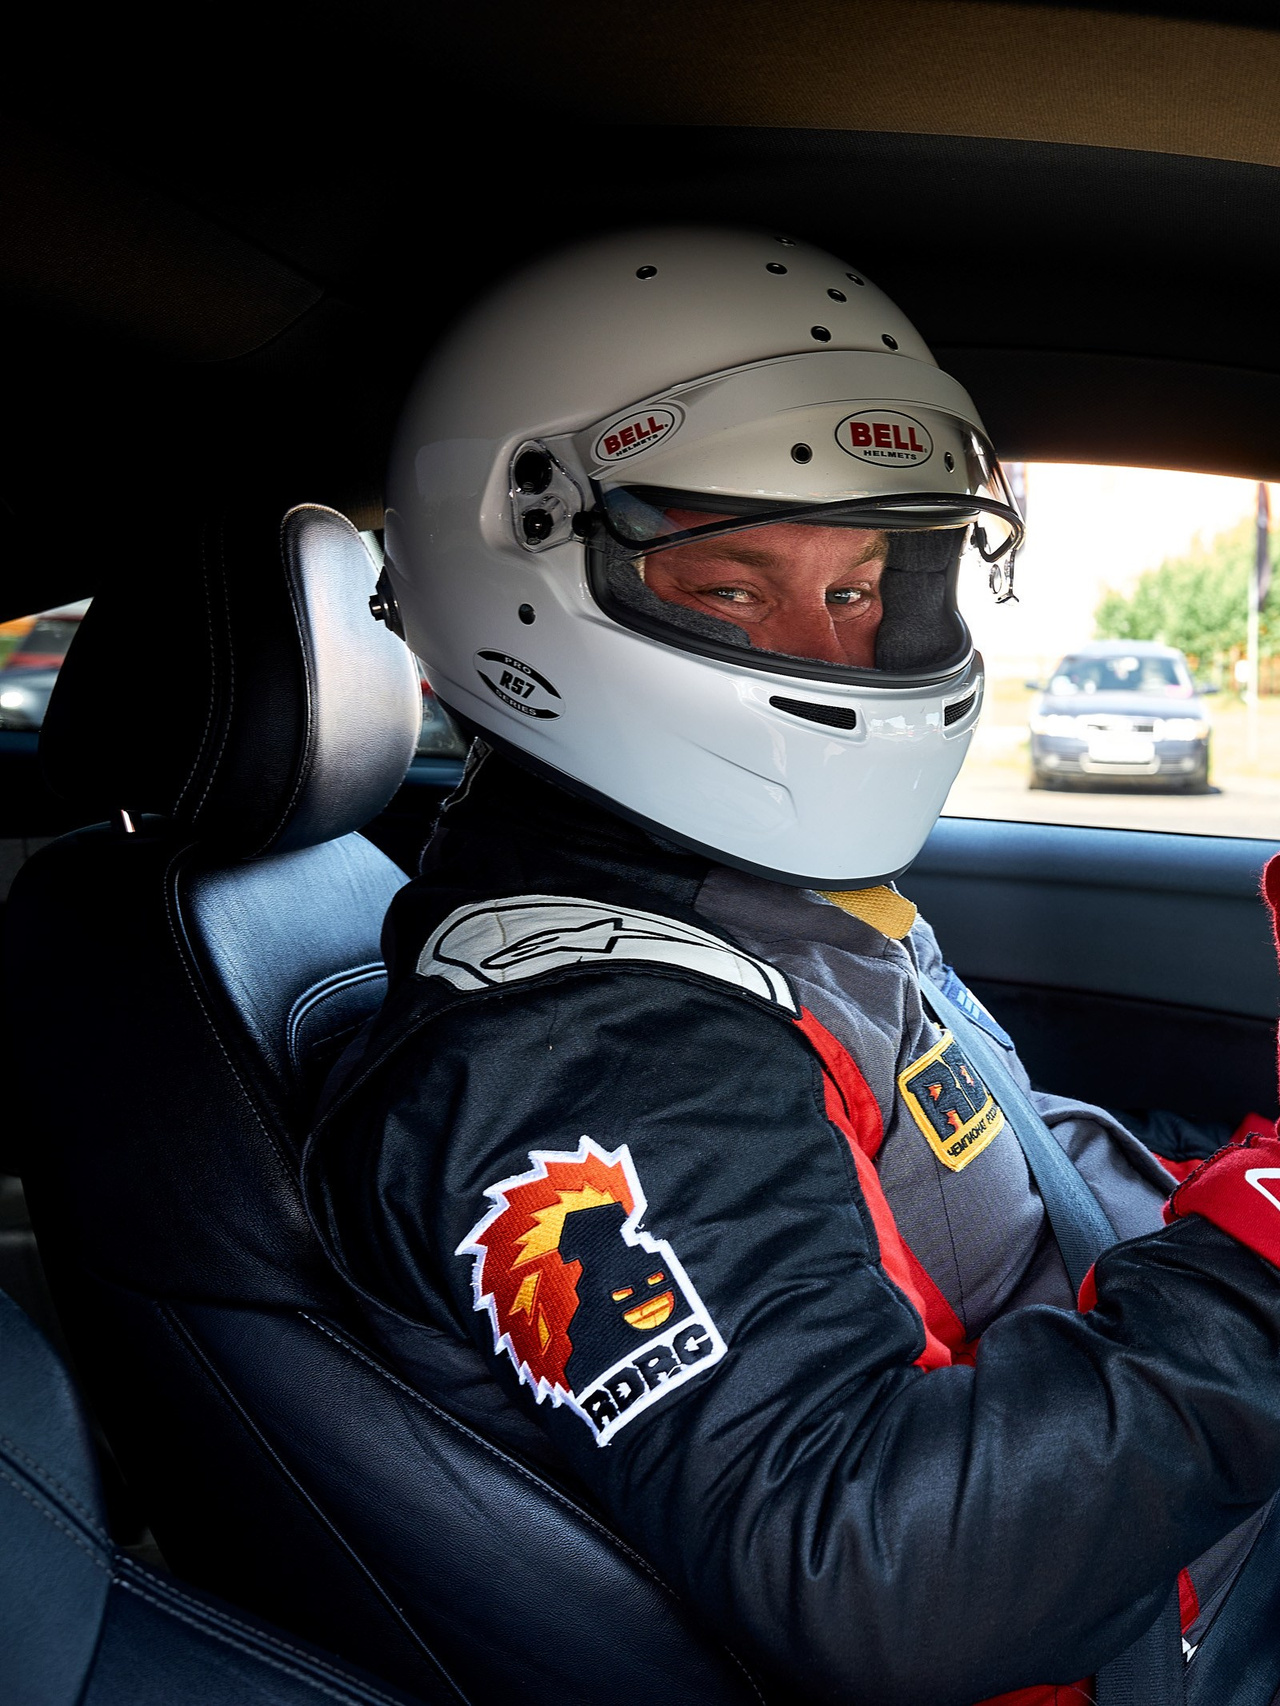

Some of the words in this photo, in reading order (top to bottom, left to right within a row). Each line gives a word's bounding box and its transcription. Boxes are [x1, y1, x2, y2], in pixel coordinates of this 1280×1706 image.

[603, 416, 665, 455] BELL
[615, 433, 659, 457] HELMETS
[849, 422, 924, 453] BELL
[863, 449, 917, 461] HELMETS
[504, 656, 532, 675] PRO
[499, 670, 536, 699] RS7
[495, 689, 537, 716] SERIES
[580, 1323, 714, 1430] RDRC
